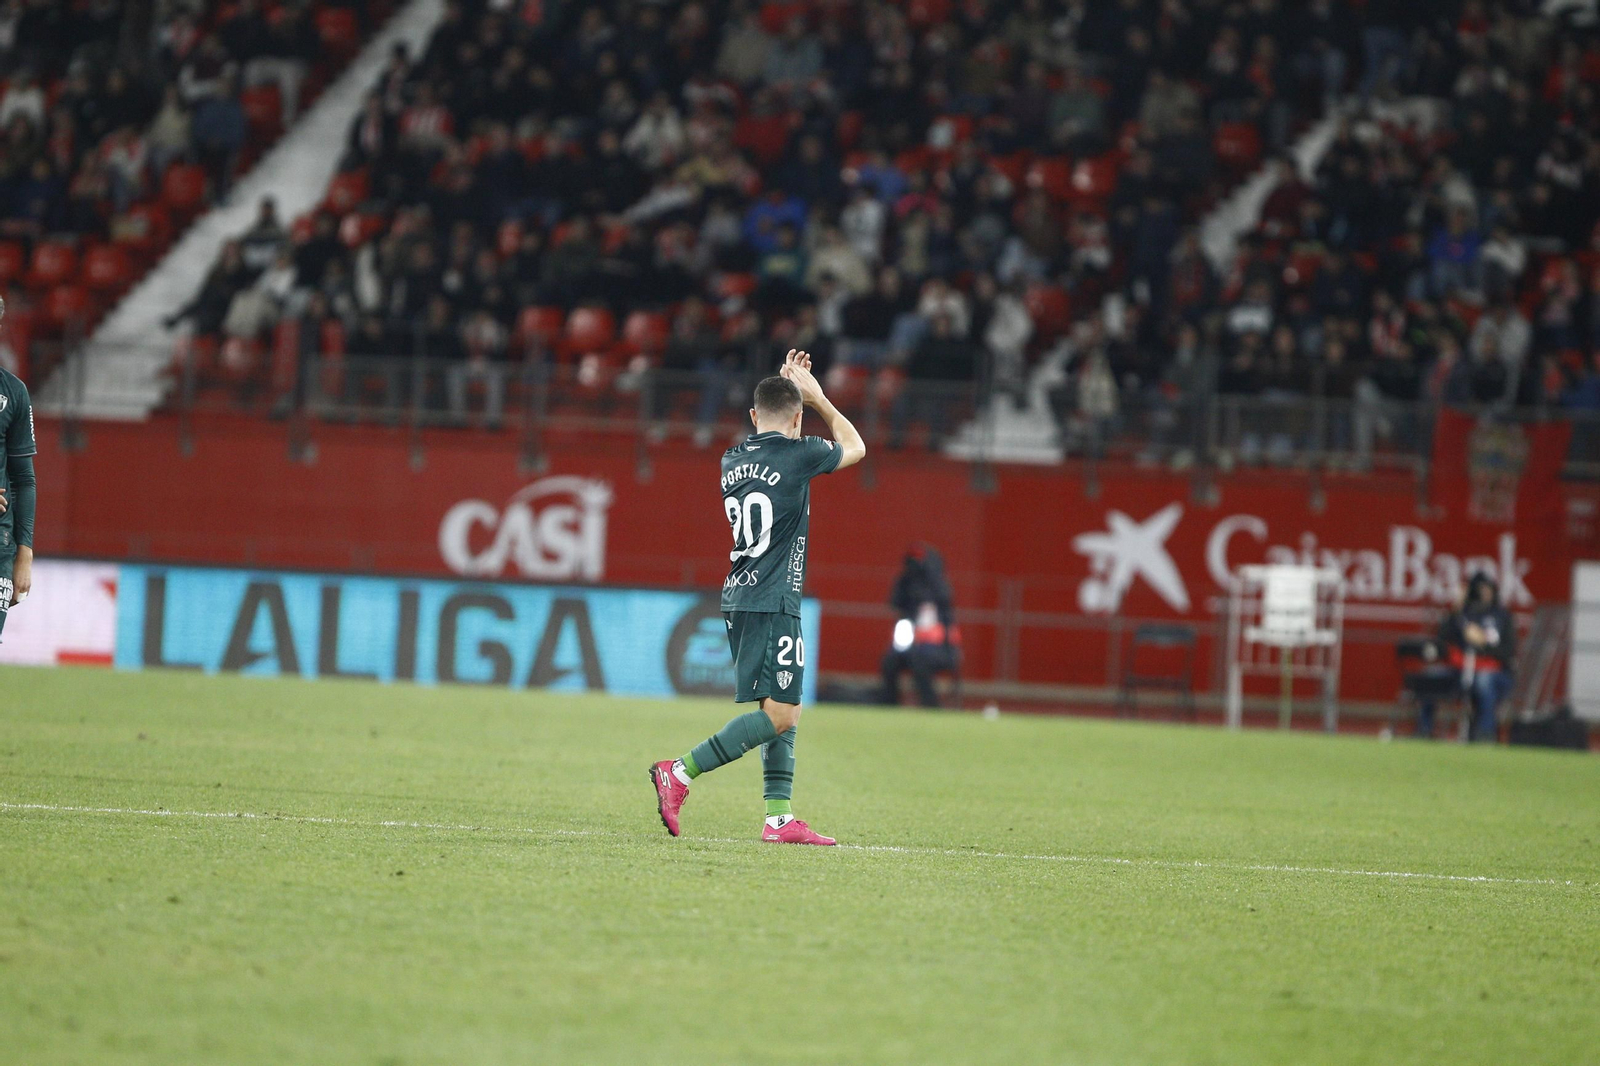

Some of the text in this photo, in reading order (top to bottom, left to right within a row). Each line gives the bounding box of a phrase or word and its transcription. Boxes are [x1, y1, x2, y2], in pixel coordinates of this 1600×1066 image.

[721, 463, 781, 491] PORTILLO
[438, 476, 613, 580] CASI
[142, 575, 606, 690] LALIGA
[777, 635, 804, 667] 20
